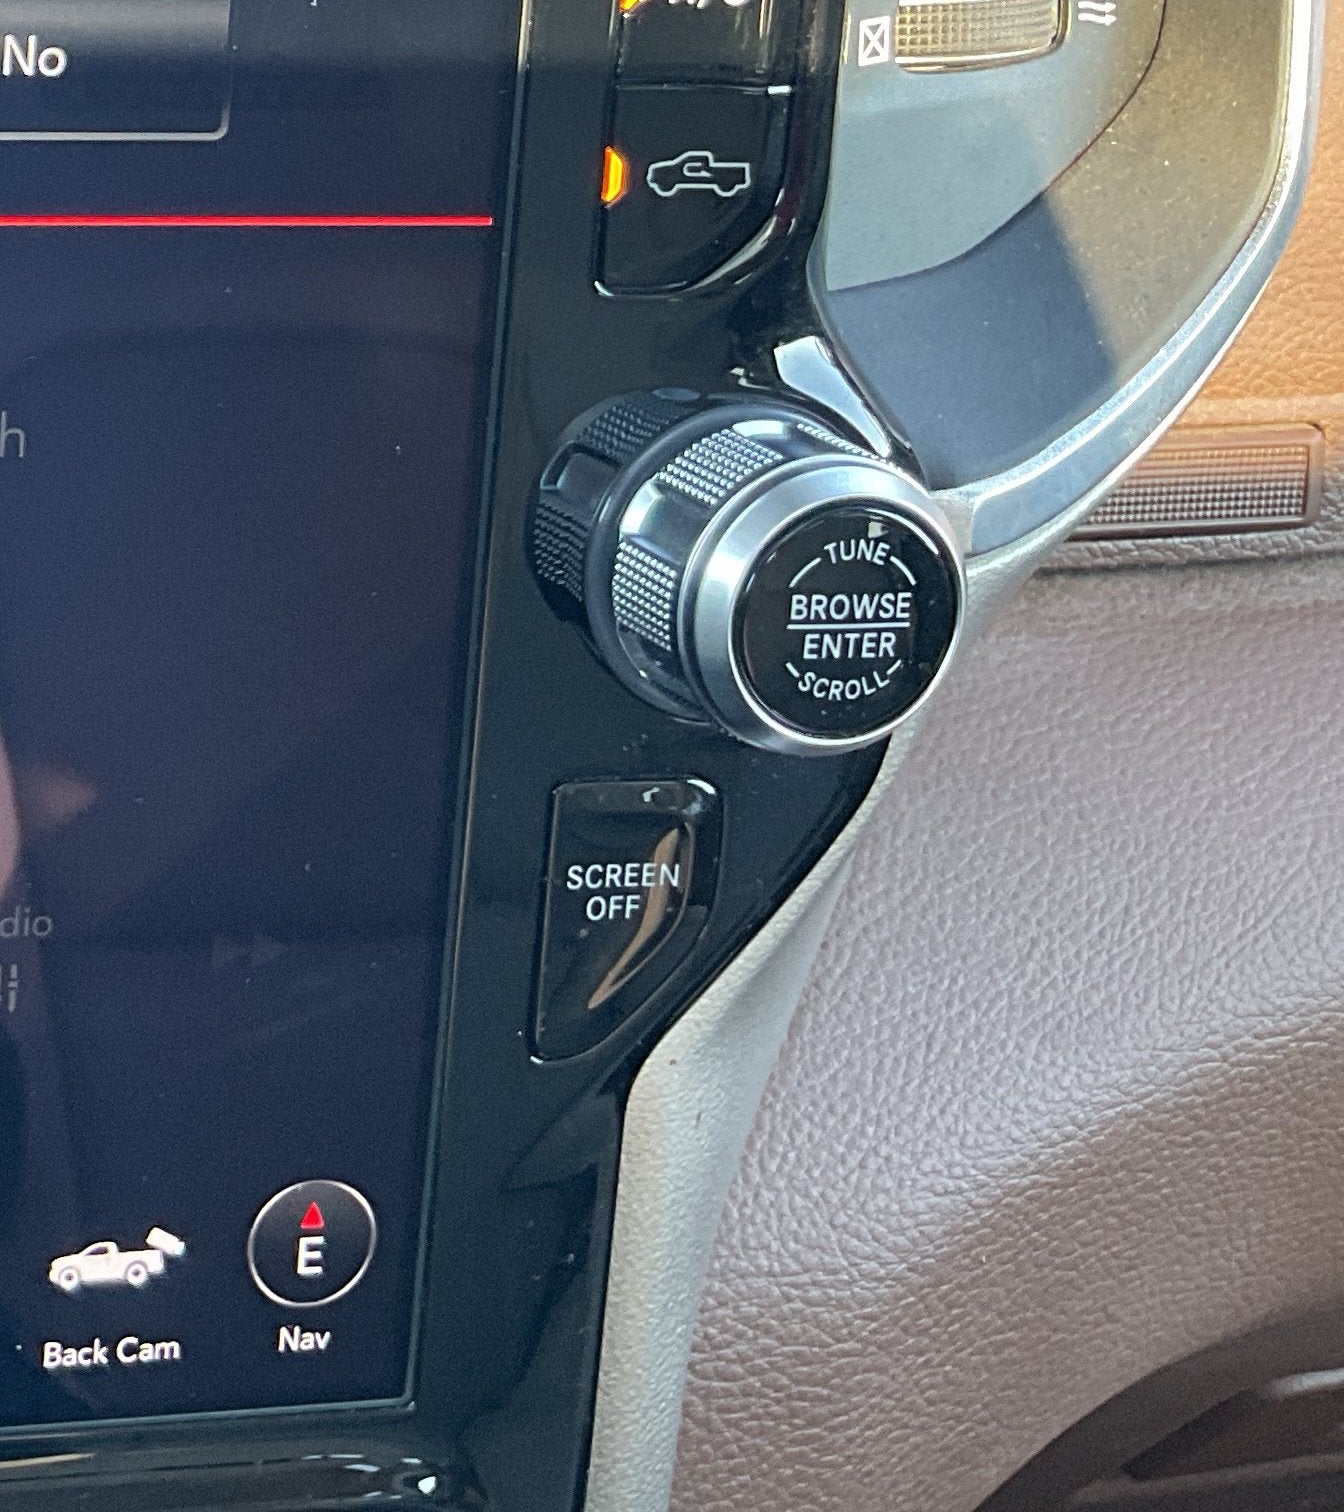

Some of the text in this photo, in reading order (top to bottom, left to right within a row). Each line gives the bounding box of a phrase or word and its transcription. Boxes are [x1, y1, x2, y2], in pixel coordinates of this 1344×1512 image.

[3, 34, 66, 76] No
[824, 537, 892, 566] TUNE
[791, 592, 912, 620] BROWSE
[802, 632, 897, 660] ENTER
[797, 668, 891, 701] SCROLL
[566, 862, 680, 889] SCREEN
[587, 895, 640, 921] OFF
[43, 1336, 180, 1369] Back Cam
[278, 1326, 330, 1352] Nav
